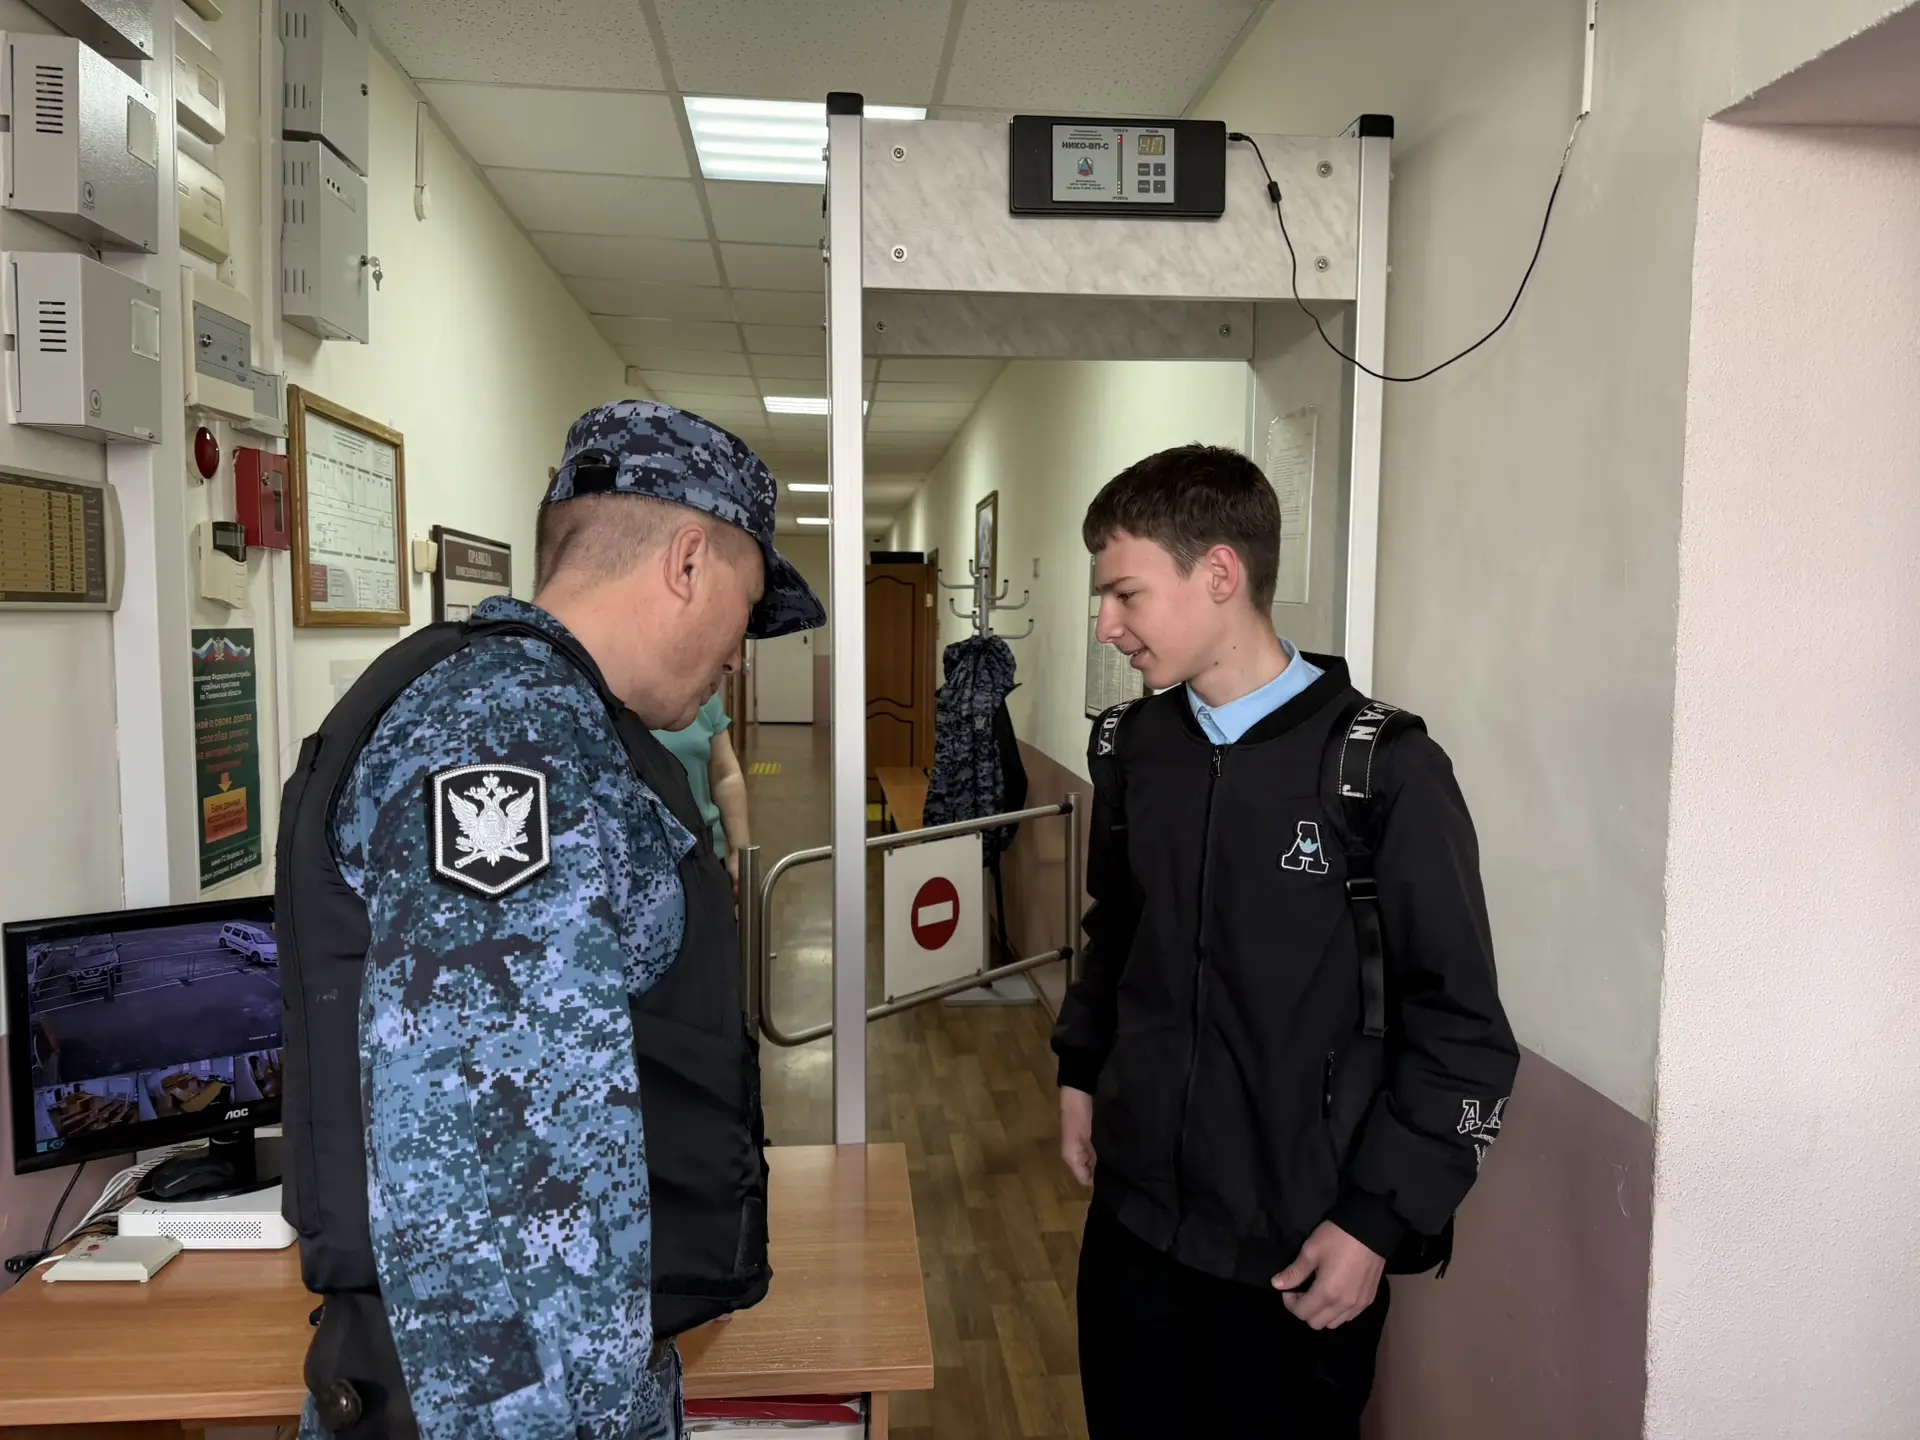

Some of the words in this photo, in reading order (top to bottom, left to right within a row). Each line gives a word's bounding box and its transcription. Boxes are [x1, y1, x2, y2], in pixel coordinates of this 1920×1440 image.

[1061, 141, 1110, 150] НИКО-ВП-С
[1281, 820, 1330, 875] A
[224, 1107, 249, 1120] AOC
